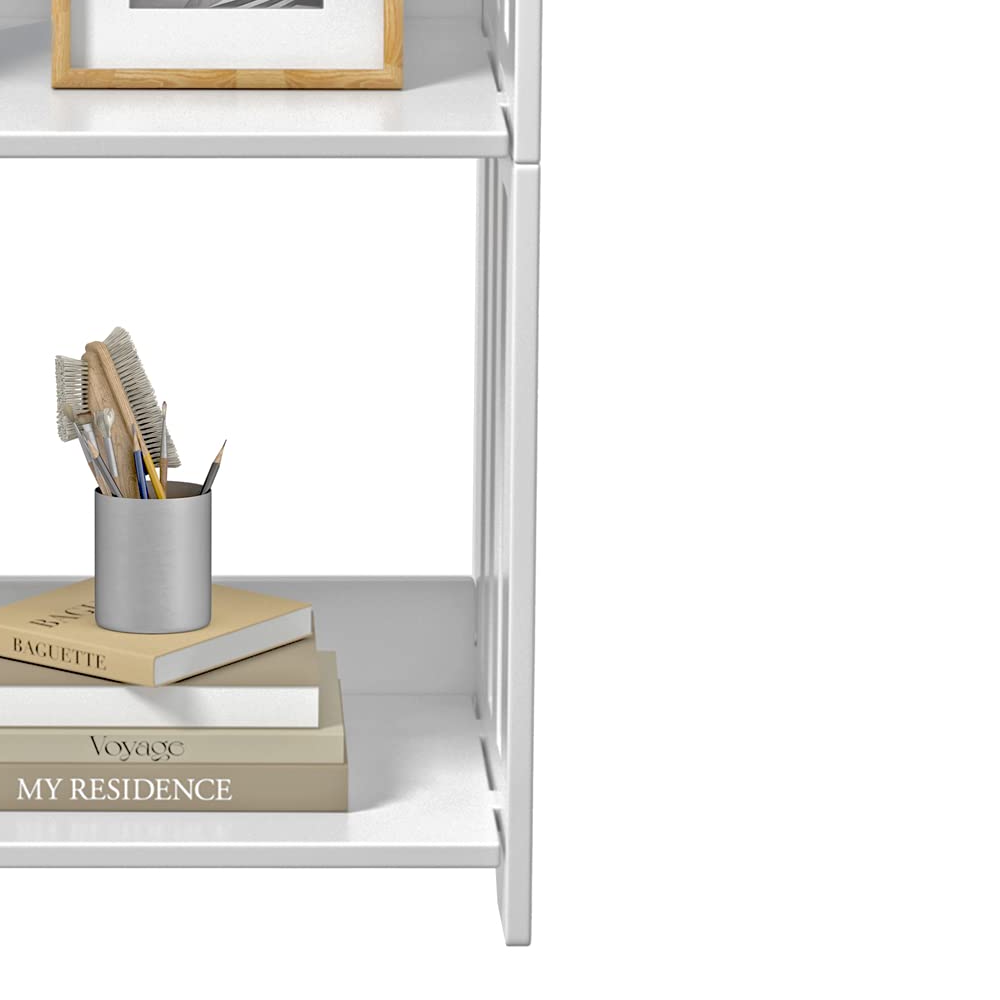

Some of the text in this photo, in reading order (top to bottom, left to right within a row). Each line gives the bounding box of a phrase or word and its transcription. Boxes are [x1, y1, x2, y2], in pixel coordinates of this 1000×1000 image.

[13, 637, 107, 671] BAGUETTE
[89, 736, 186, 762] Voyage
[17, 778, 233, 801] MY RESIDENCE
